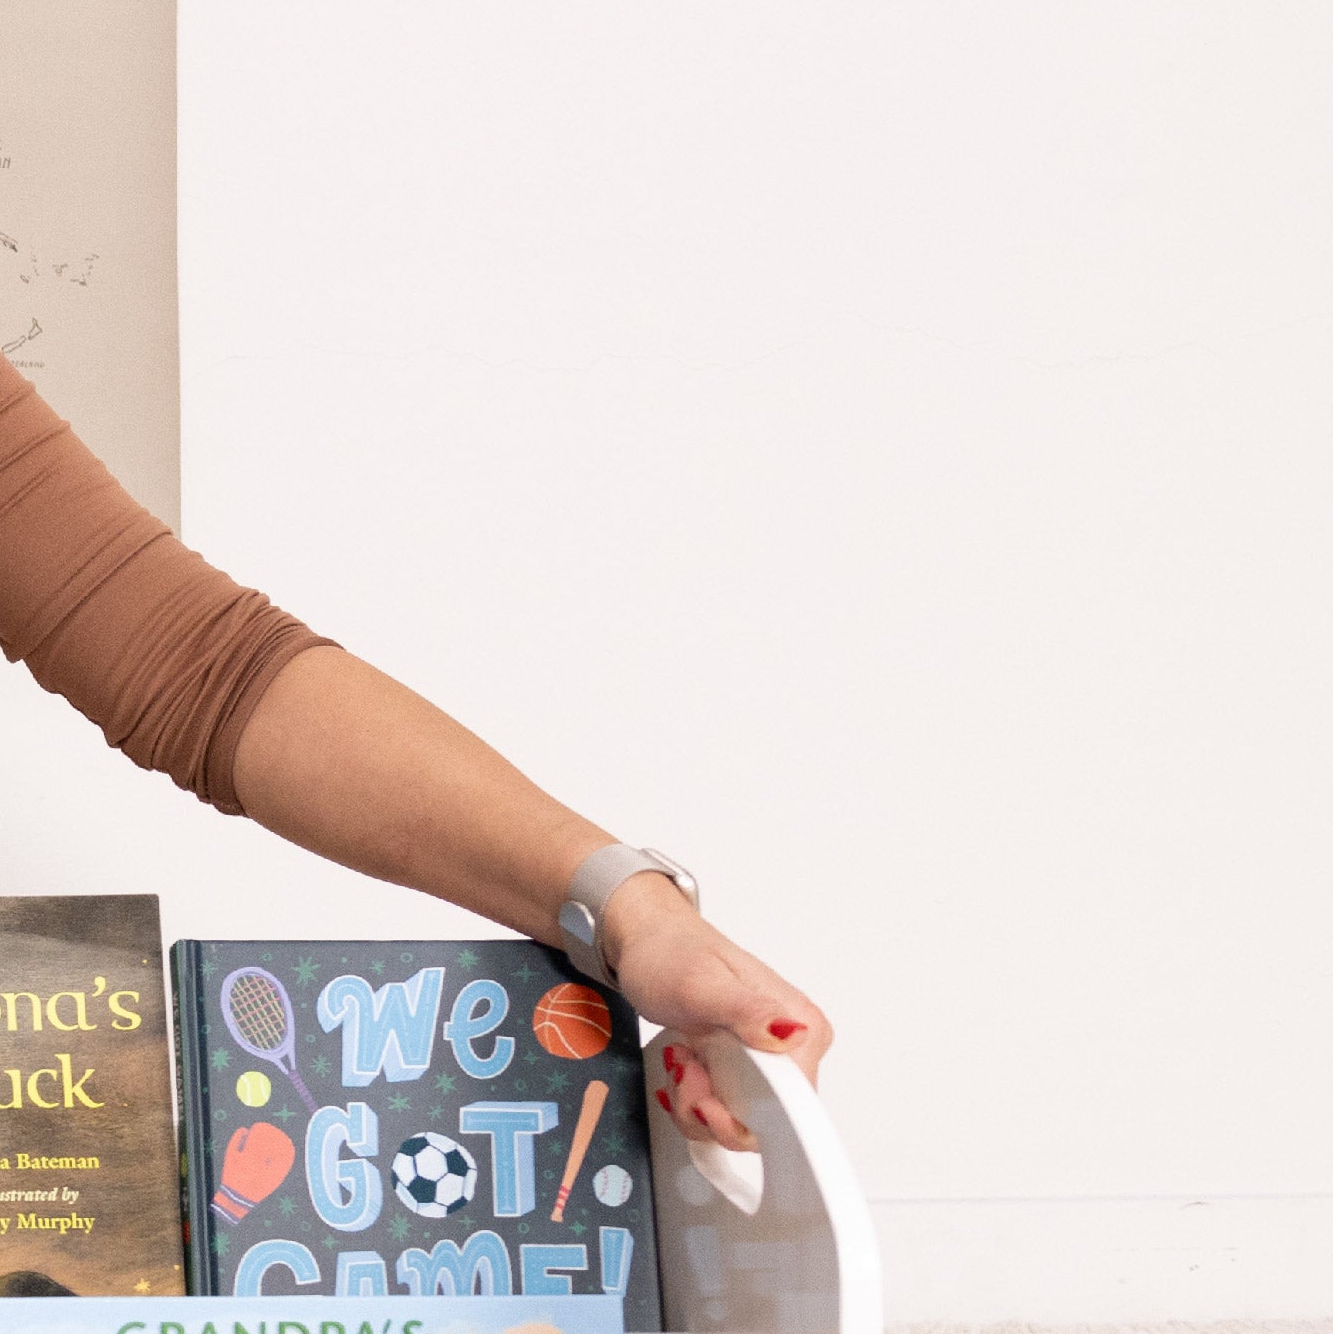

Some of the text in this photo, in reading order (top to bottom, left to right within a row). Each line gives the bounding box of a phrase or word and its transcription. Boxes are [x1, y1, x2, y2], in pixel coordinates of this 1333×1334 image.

[316, 966, 515, 1088] We
[16, 1152, 100, 1170] Bateman
[61, 1186, 80, 1204] by
[17, 1212, 96, 1234] Murphy
